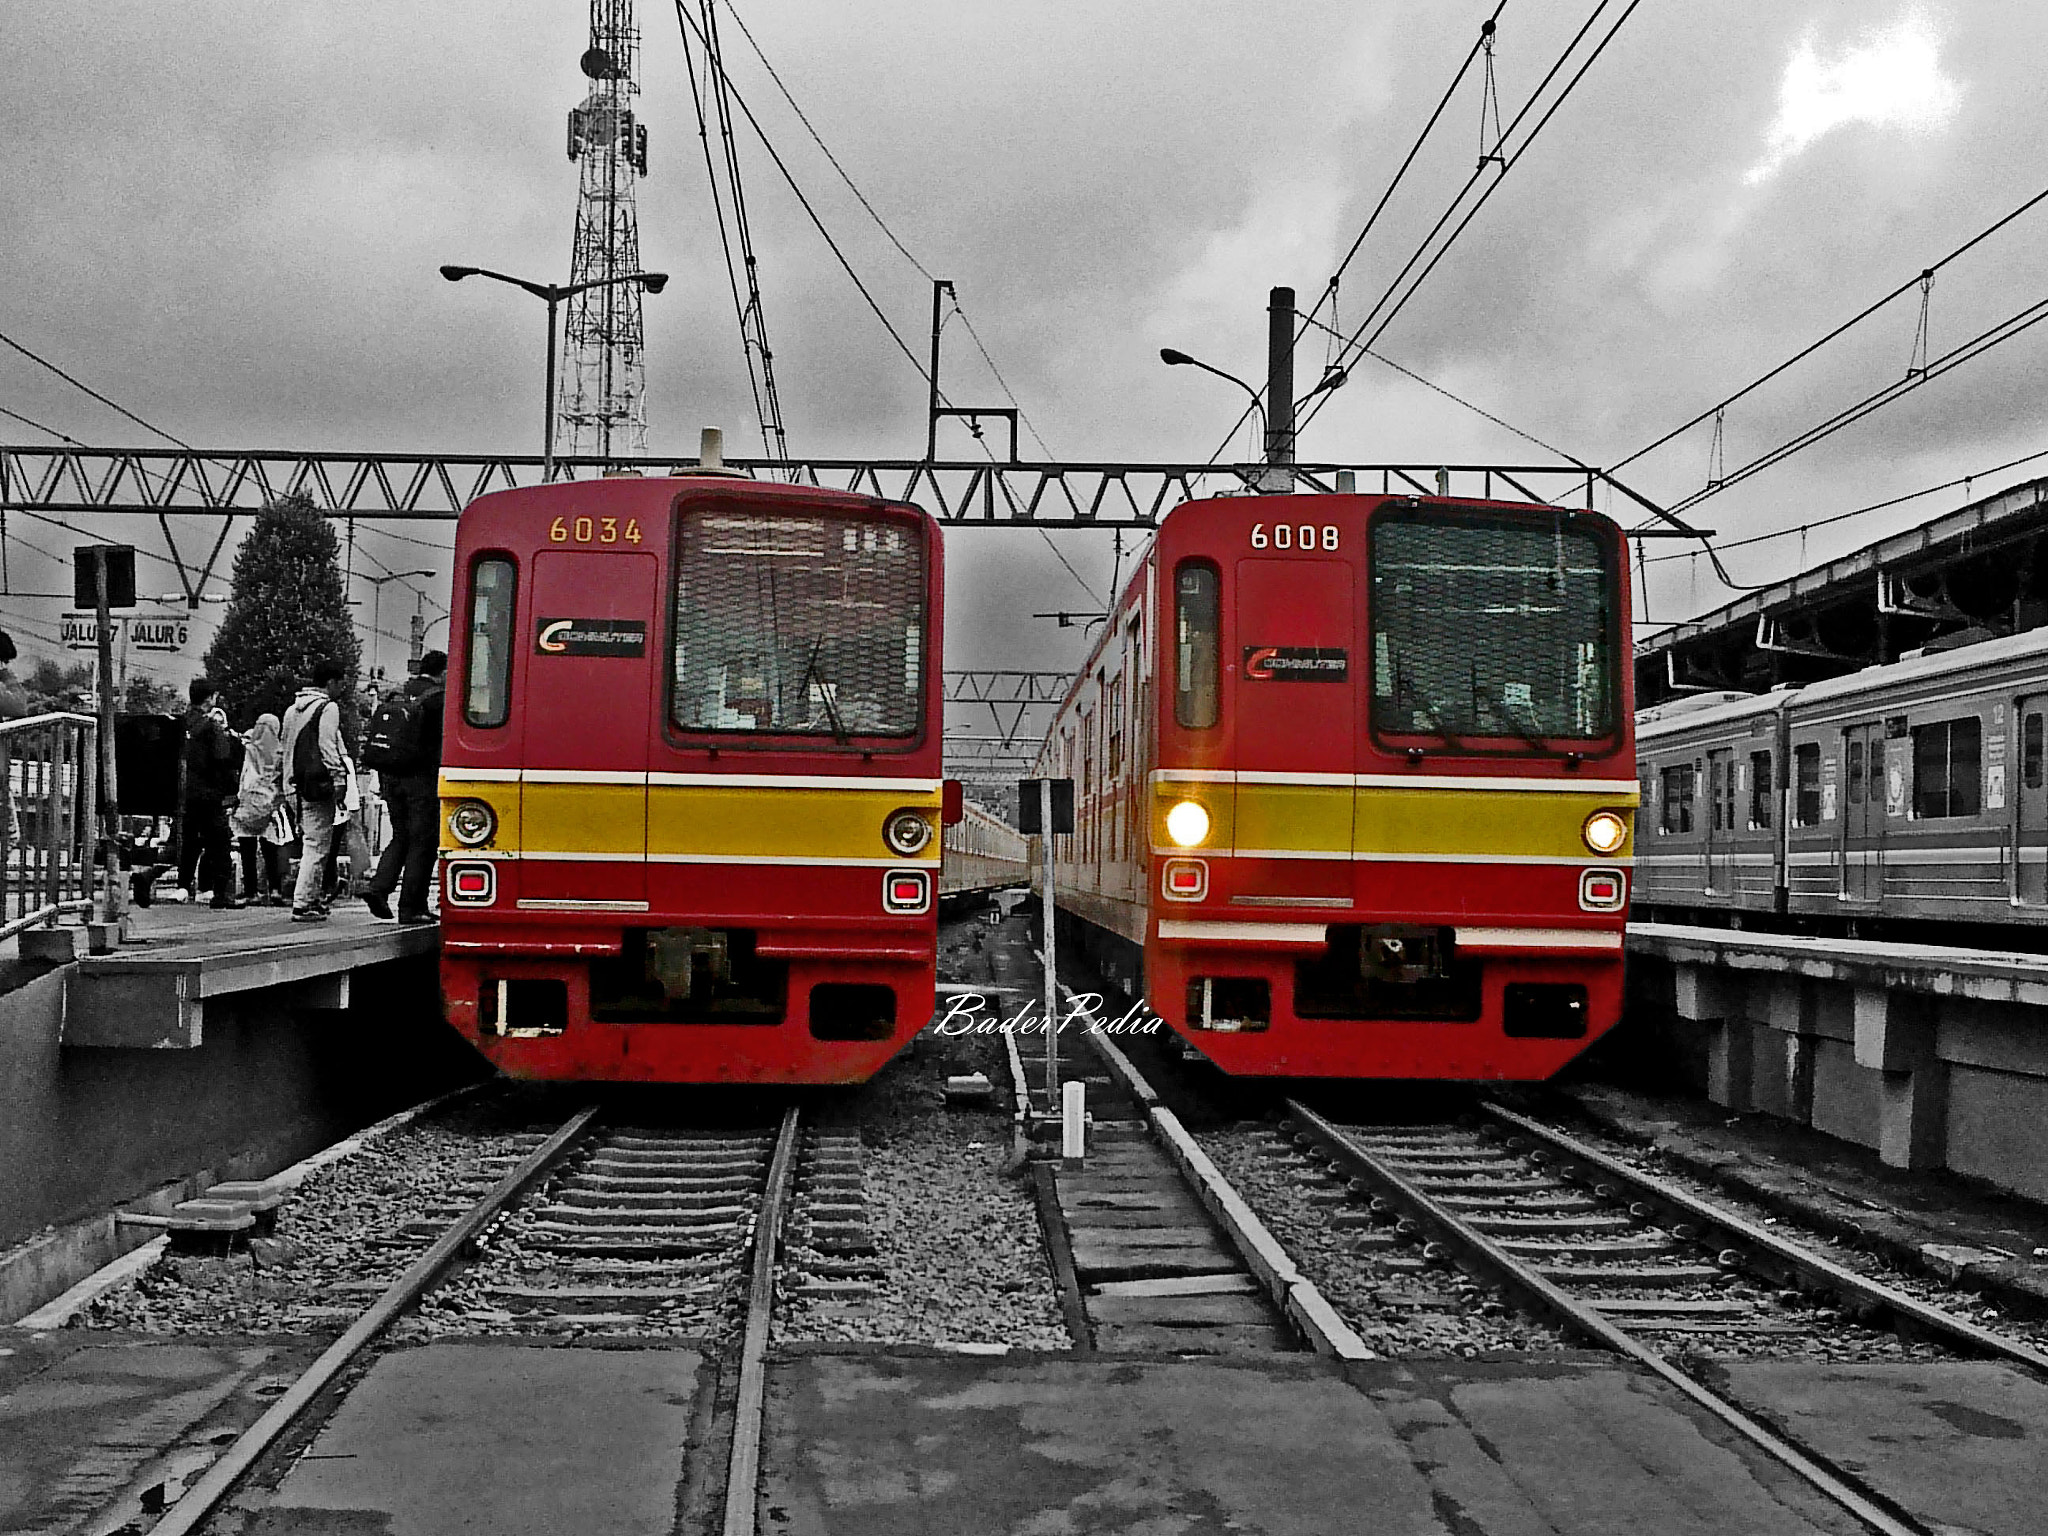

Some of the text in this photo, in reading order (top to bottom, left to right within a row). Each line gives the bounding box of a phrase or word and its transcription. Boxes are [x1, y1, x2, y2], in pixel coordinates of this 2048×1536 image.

[550, 516, 642, 544] 6034
[1251, 523, 1339, 551] 6008
[61, 623, 98, 642] JALU
[130, 624, 188, 644] JALUR 6
